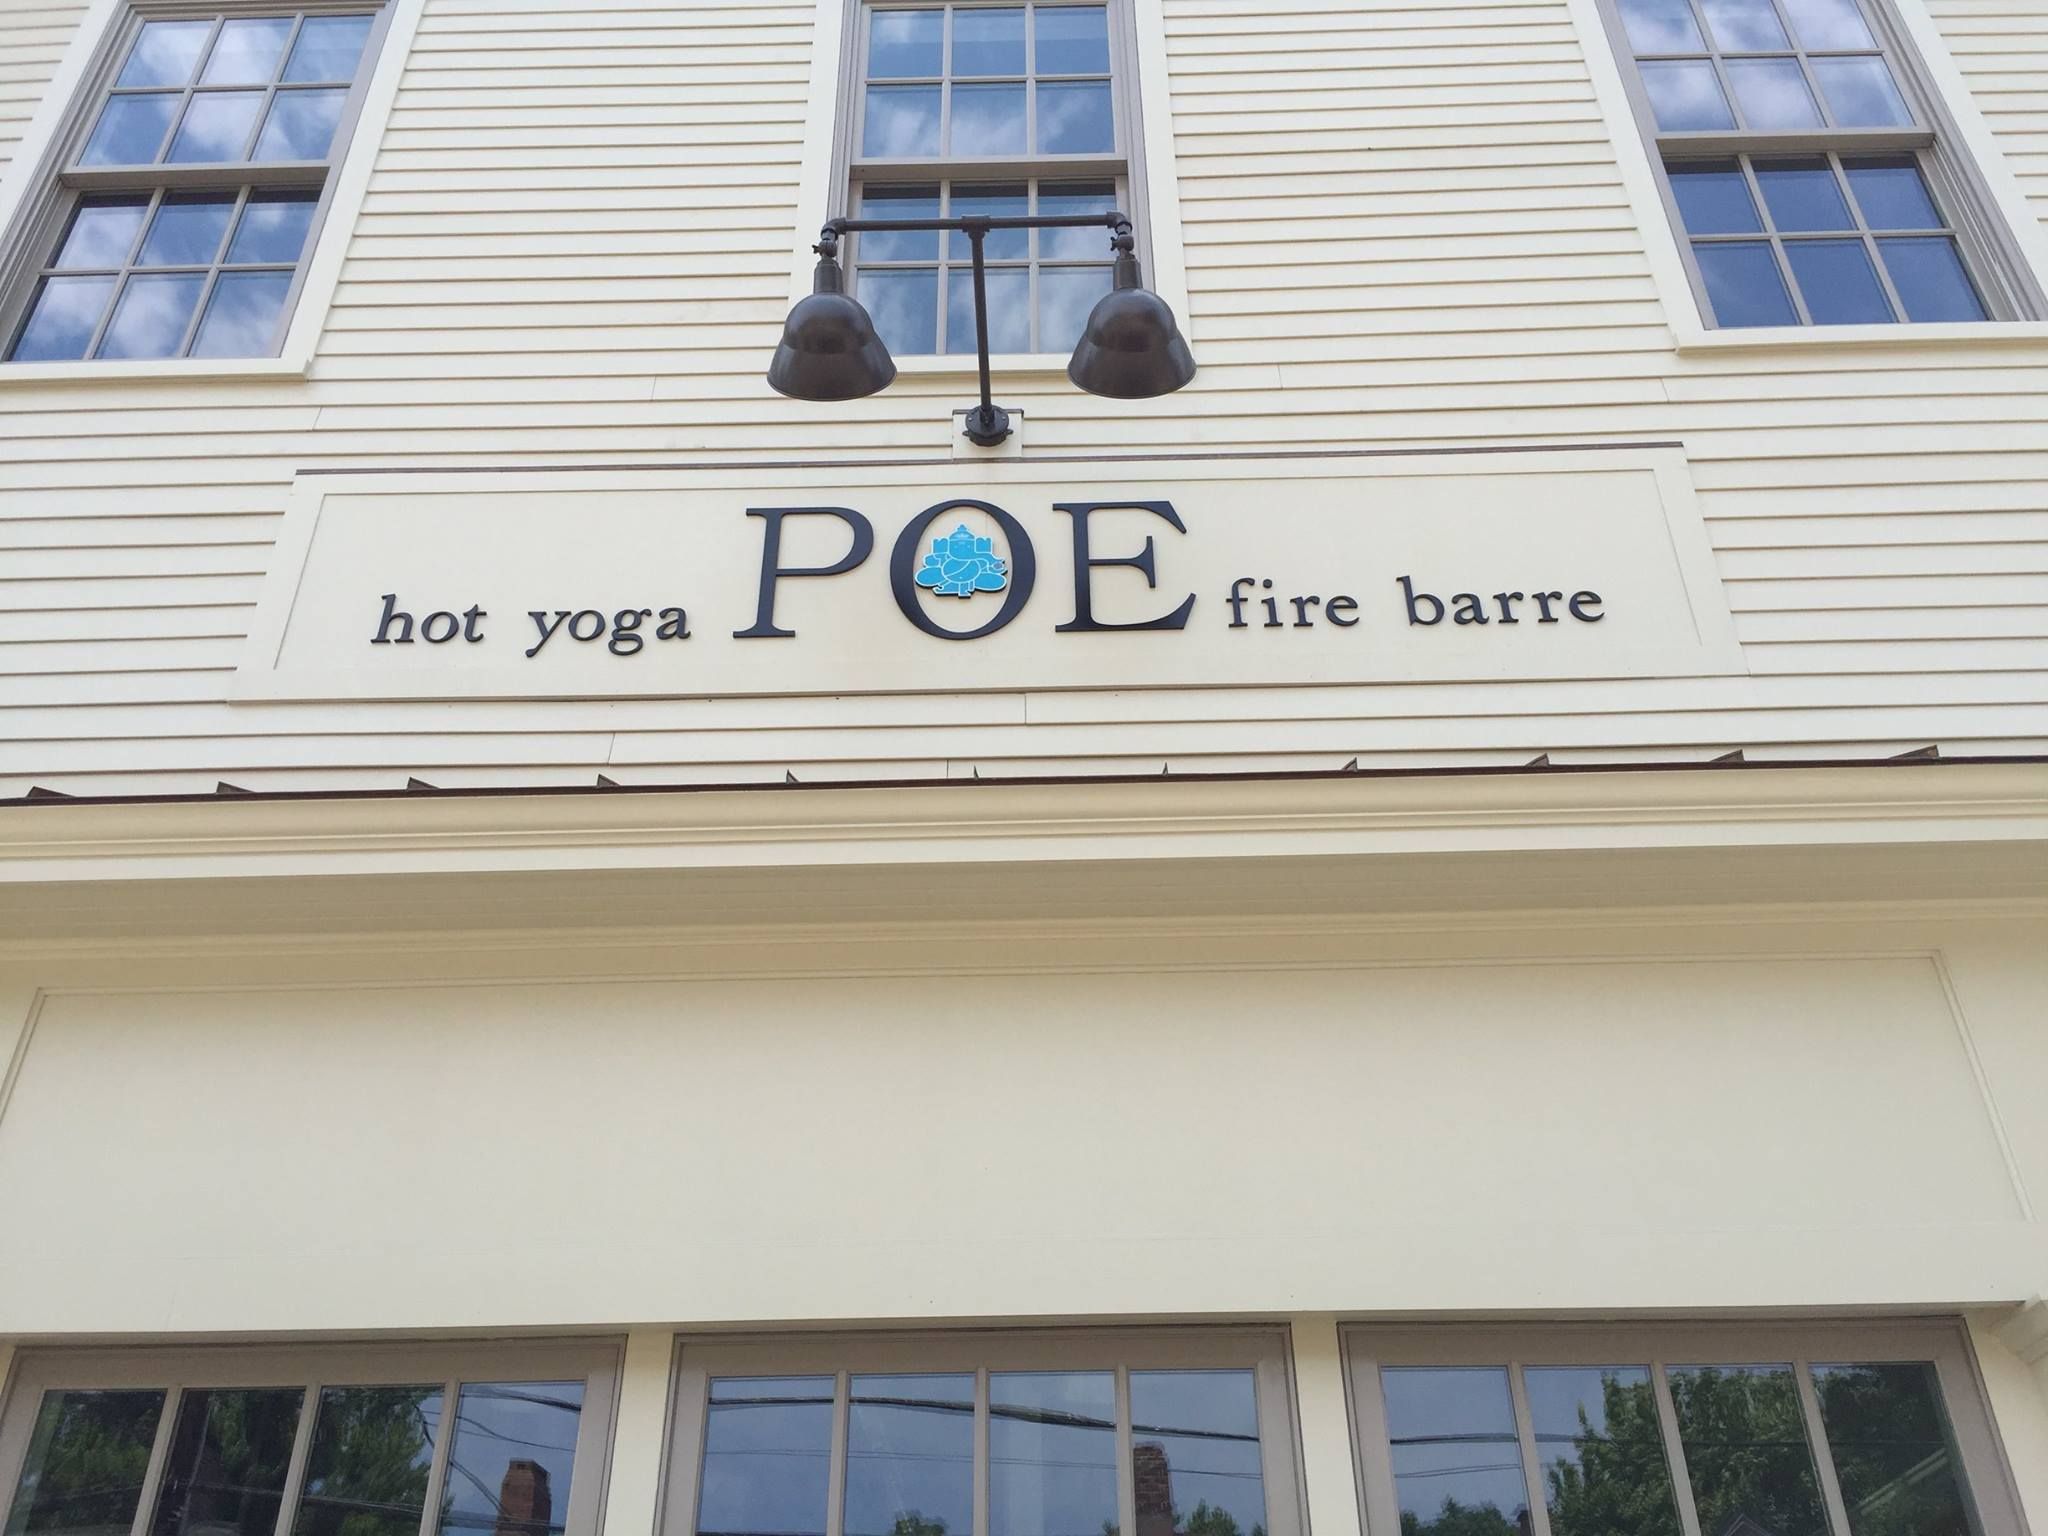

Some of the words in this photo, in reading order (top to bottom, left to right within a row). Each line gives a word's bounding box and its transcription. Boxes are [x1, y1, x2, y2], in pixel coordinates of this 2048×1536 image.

[371, 594, 487, 644] hot
[526, 607, 692, 658] yoga
[732, 500, 1197, 642] POE
[1225, 576, 1361, 629] fire
[1396, 575, 1605, 627] barre
